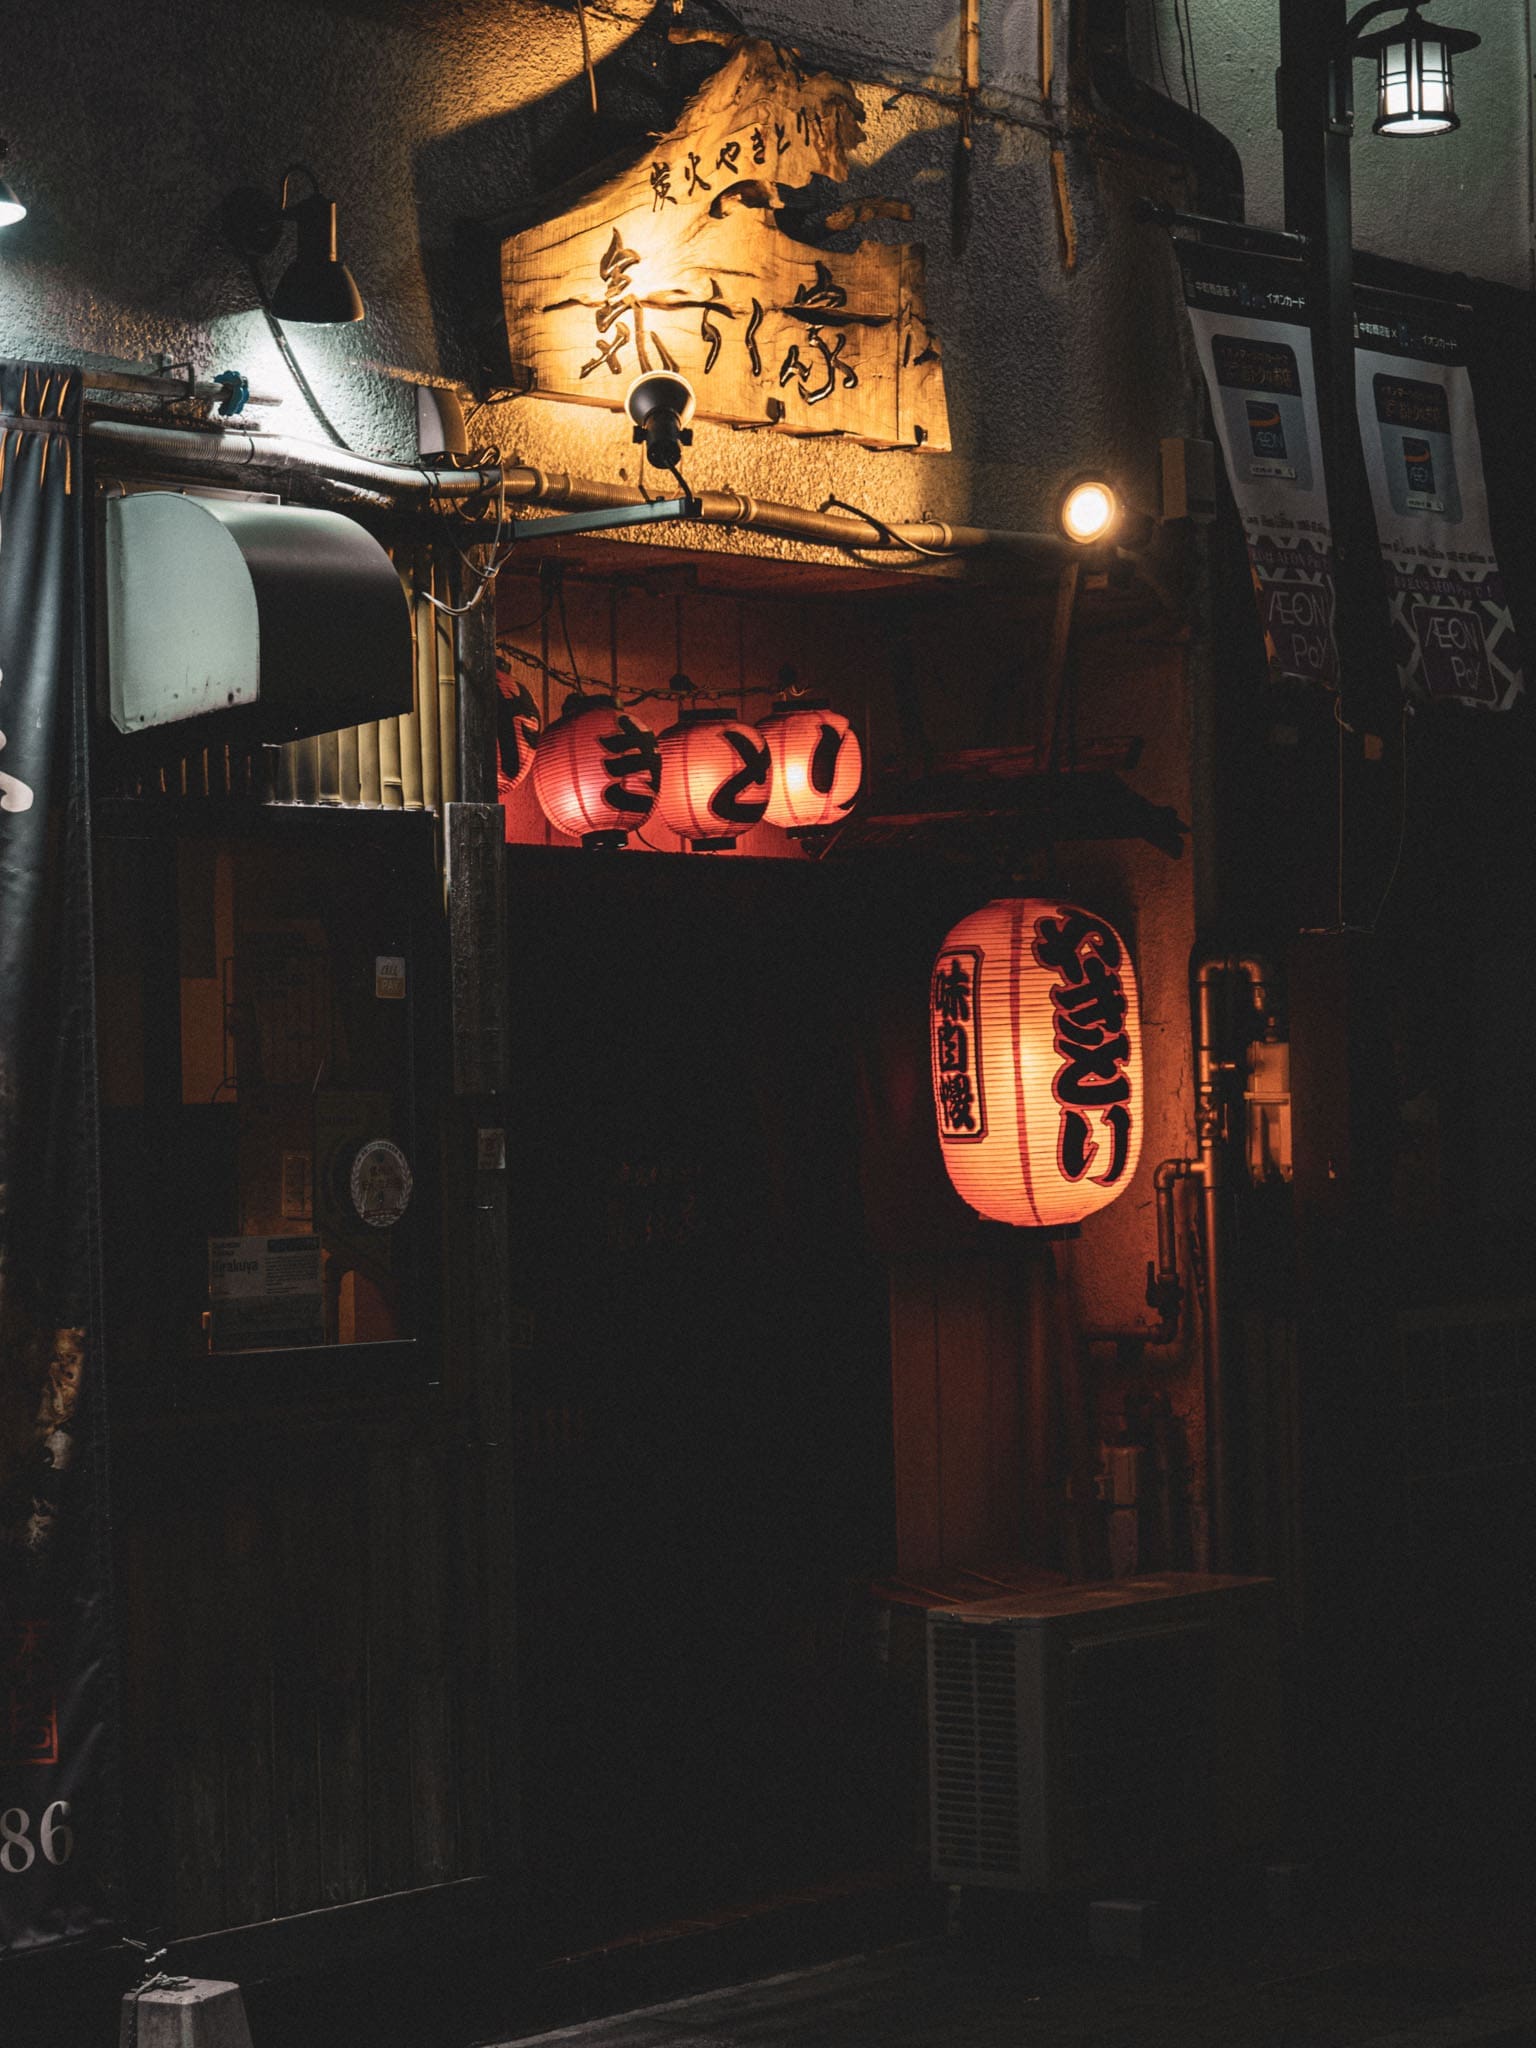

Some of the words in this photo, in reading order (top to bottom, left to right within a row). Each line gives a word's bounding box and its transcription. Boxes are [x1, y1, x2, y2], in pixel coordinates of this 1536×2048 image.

[651, 107, 812, 212] 炭火やきとり
[1266, 292, 1306, 309] イオンカード
[935, 957, 977, 1131] 味自慢
[1033, 907, 1131, 1184] やきとり
[0, 1800, 74, 1873] 86
